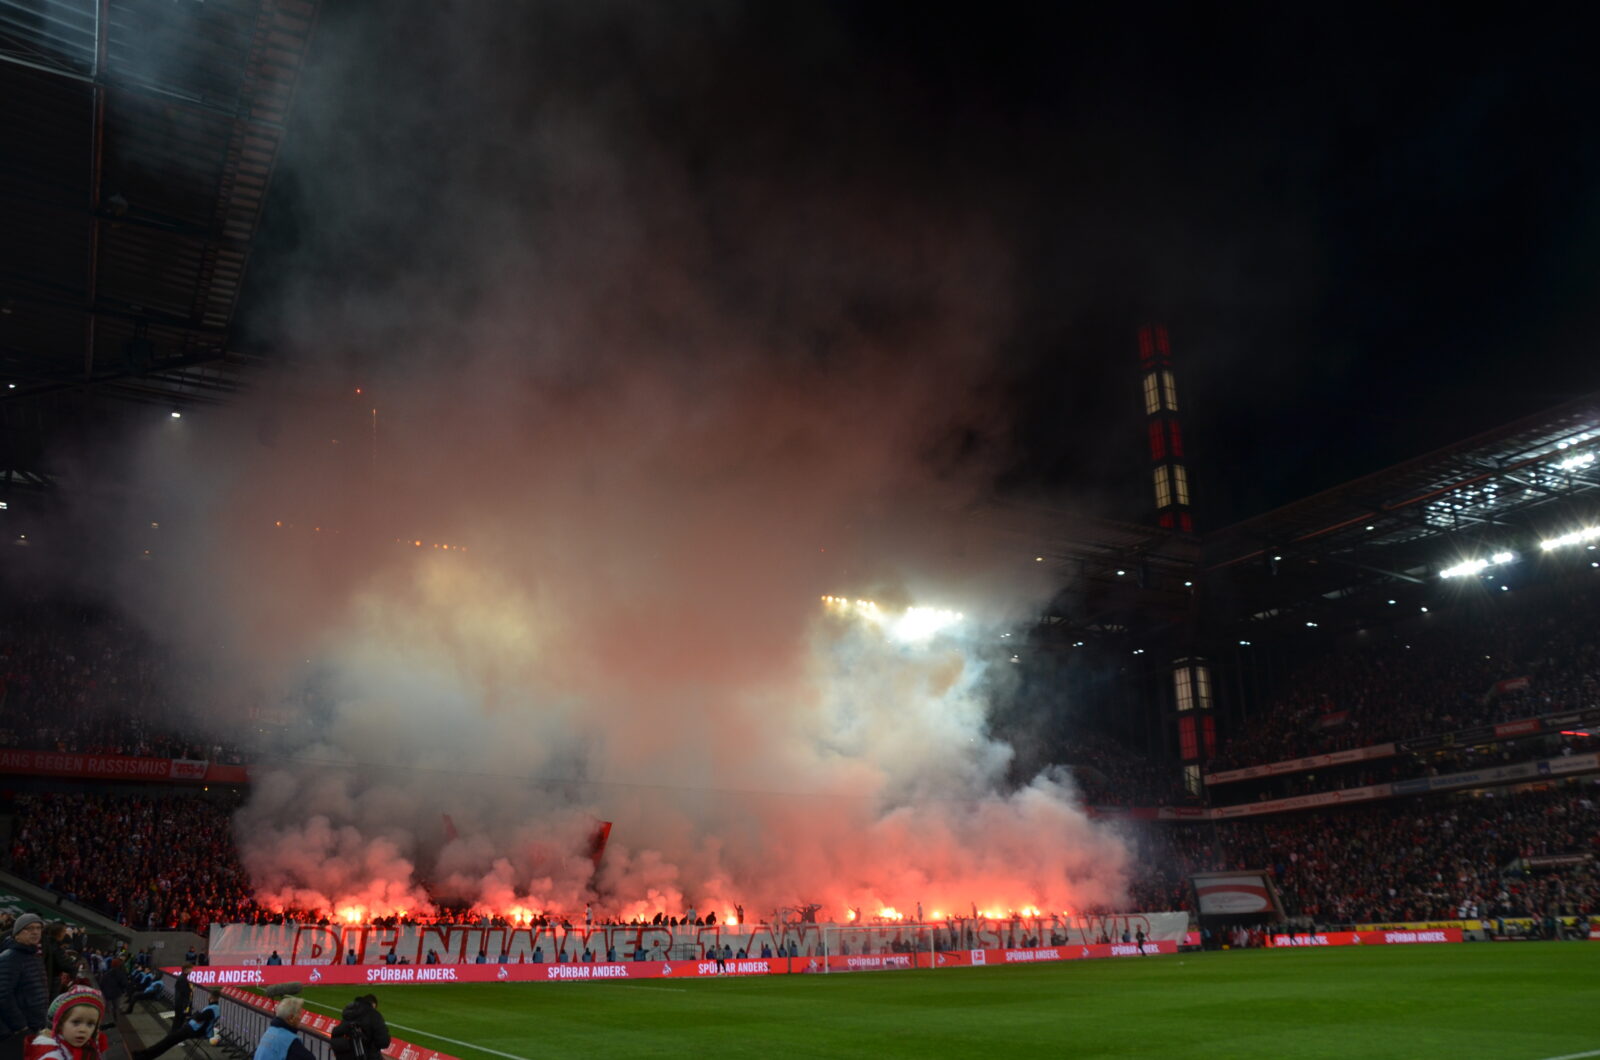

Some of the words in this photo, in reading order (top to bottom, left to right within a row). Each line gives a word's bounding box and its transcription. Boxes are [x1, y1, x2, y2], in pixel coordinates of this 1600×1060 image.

[0, 752, 30, 768] ANS
[35, 754, 83, 772] GEGEN
[87, 757, 168, 776] RASSISMUS
[291, 925, 399, 965] DIE
[416, 926, 673, 965] NUMMER
[746, 925, 822, 958] AM
[1077, 914, 1152, 945] WIR
[1005, 950, 1034, 961] SPÜRBAR
[1035, 949, 1060, 960] ANDERS.
[367, 966, 414, 981] SPÜRBAR
[416, 967, 458, 980] ANDERS.
[547, 964, 590, 978] SPÜRBAR
[592, 965, 629, 977] ANDERS.
[698, 960, 736, 974] SPÜAR
[738, 961, 771, 973] ANDERS.
[218, 969, 265, 983] ANDERS.
